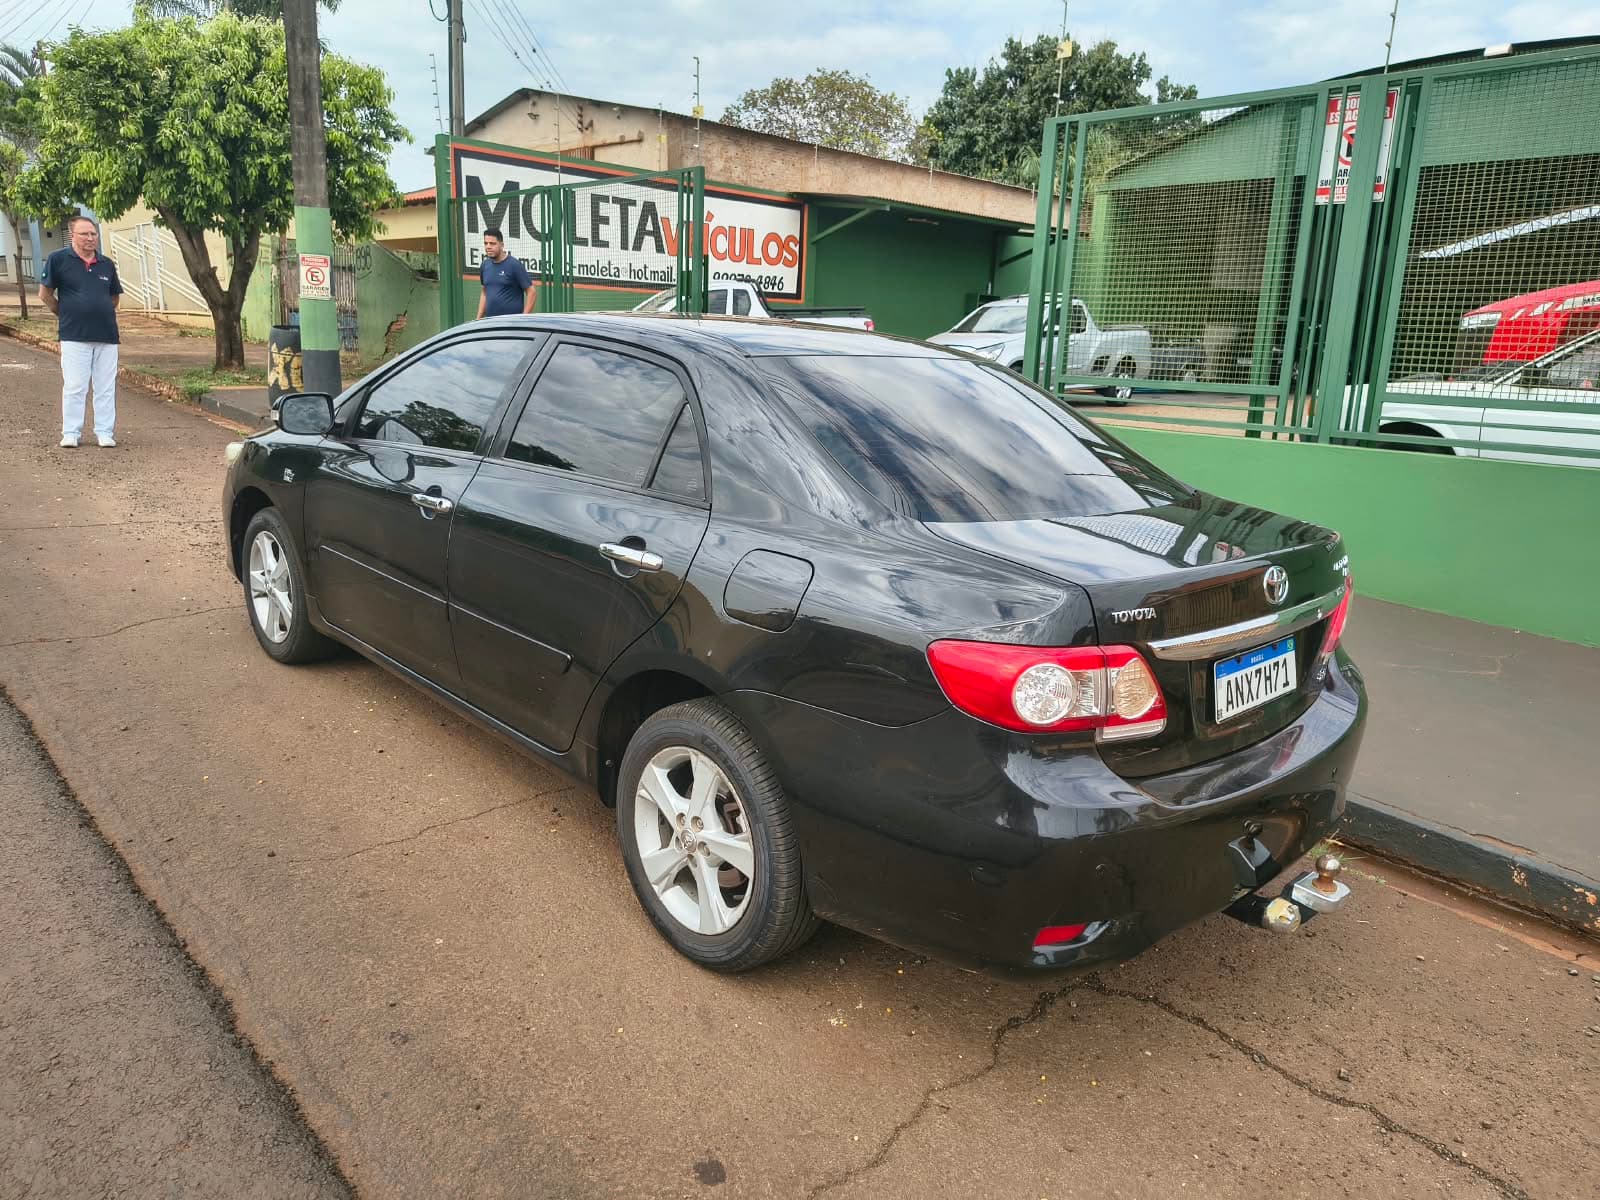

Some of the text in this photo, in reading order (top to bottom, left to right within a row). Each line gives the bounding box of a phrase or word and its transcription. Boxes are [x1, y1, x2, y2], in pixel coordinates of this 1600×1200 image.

[660, 210, 800, 268] VÍCULOS
[1111, 607, 1157, 624] TOYOTA
[1225, 657, 1290, 713] ANX7H71
